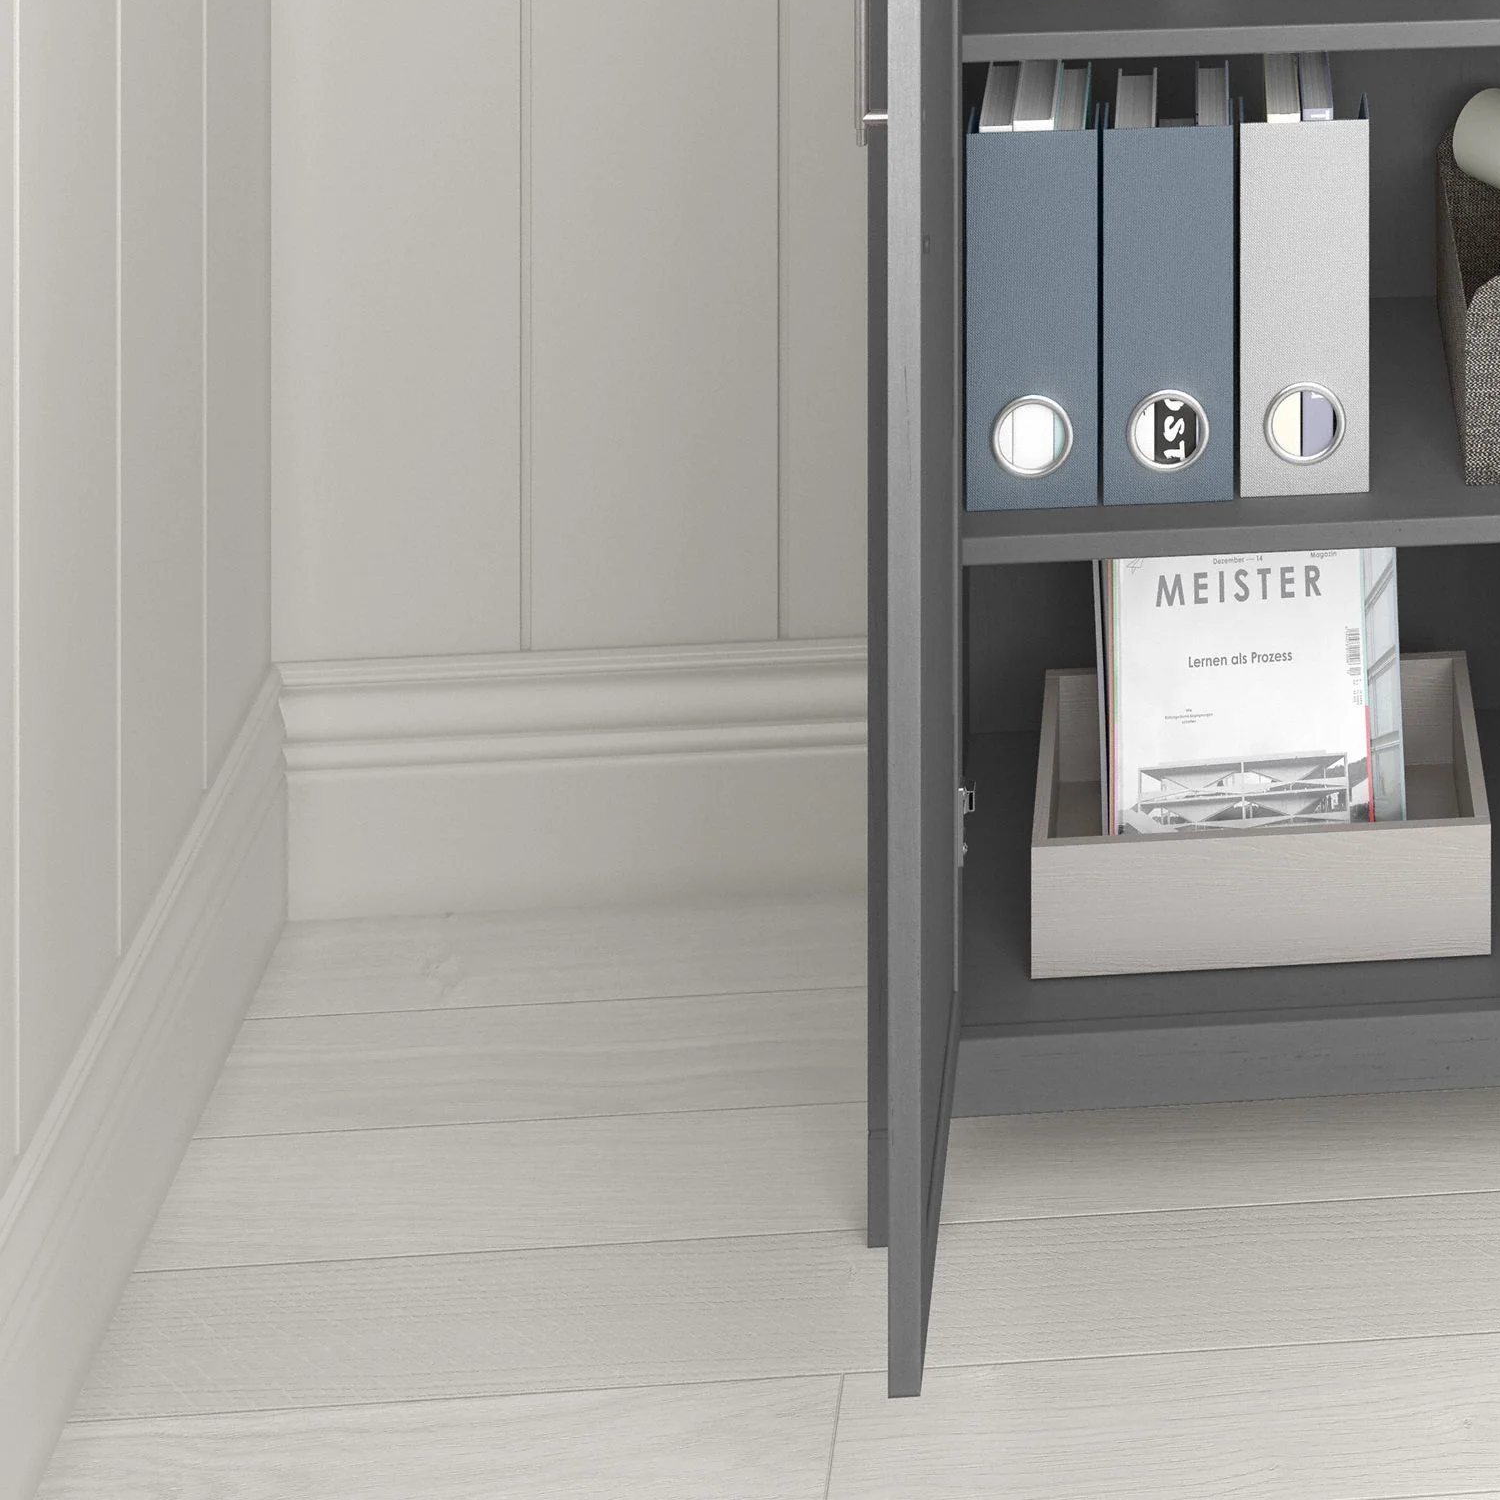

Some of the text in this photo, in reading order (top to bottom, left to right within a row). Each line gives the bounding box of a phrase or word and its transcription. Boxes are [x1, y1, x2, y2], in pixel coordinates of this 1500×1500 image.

[1213, 556, 1245, 565] Dezember
[1310, 551, 1337, 559] Magazin
[1155, 565, 1322, 607] MEISTER
[1188, 650, 1293, 668] Lernen als Prozess
